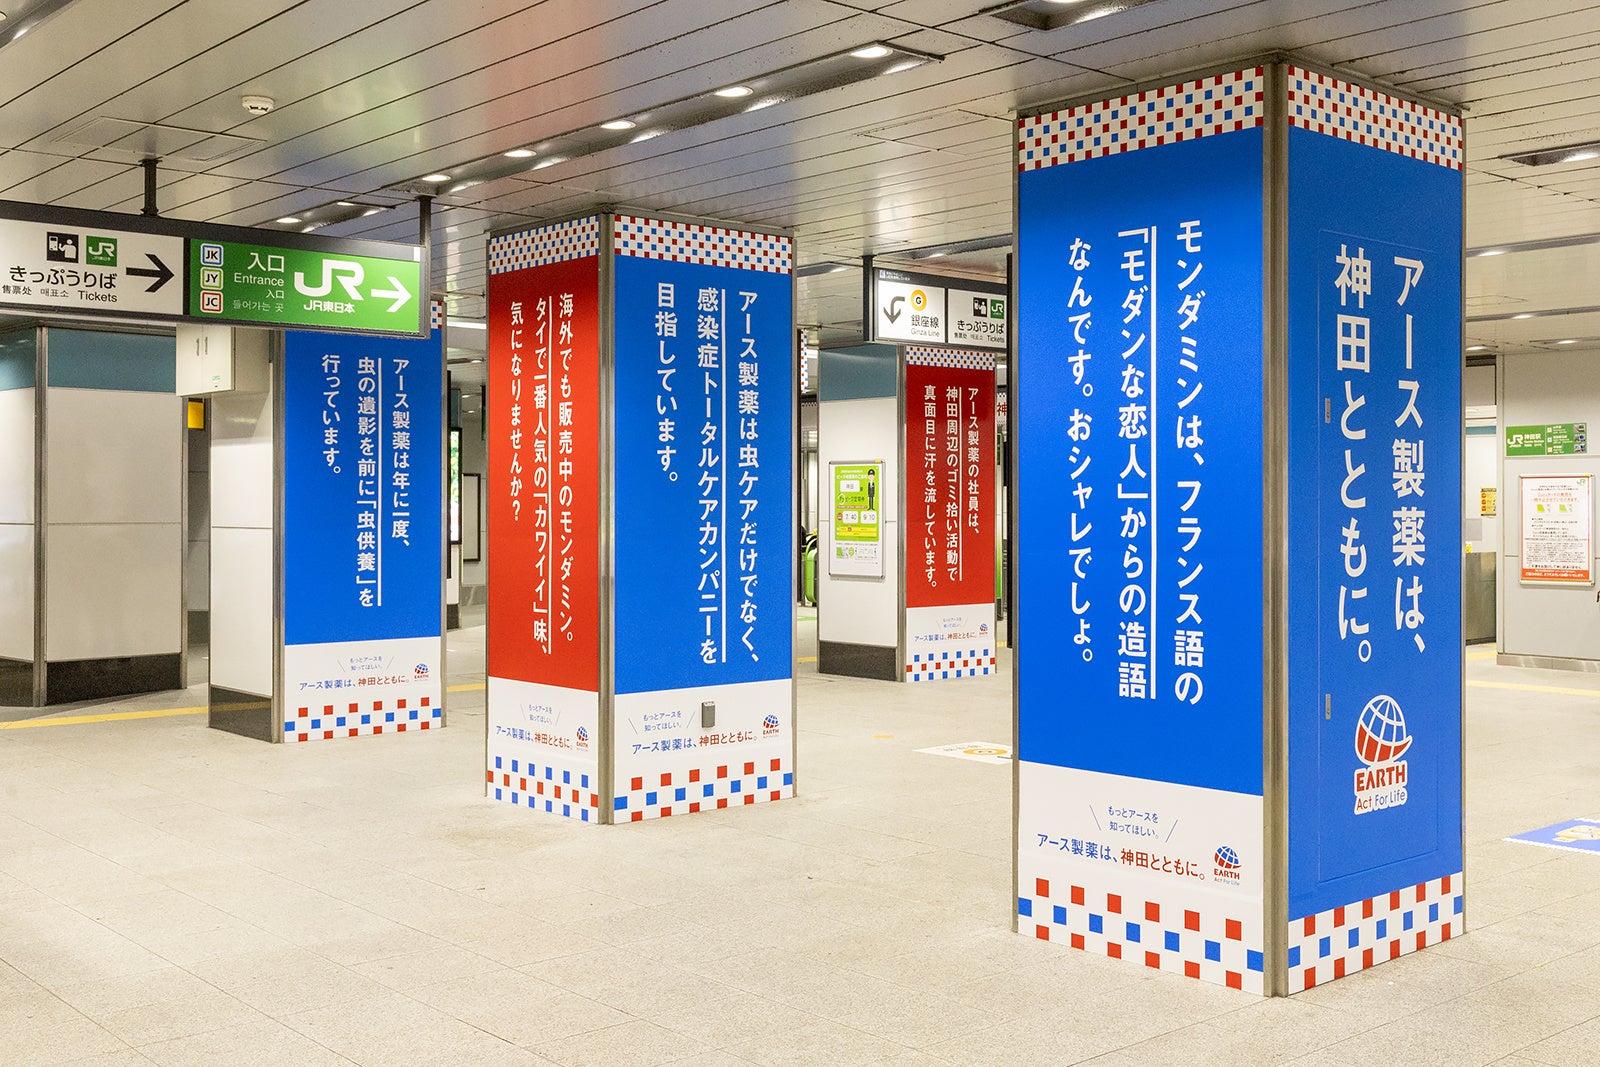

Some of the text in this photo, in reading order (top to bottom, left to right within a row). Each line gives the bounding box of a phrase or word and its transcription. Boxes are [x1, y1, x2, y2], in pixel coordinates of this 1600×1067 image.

[88, 242, 115, 256] JR
[206, 250, 219, 260] JK
[247, 252, 284, 273] 入口
[9, 265, 118, 289] きっぷうりば
[206, 273, 218, 283] JY
[234, 273, 284, 287] Entrance
[294, 258, 365, 300] JR
[78, 290, 118, 303] Tickets
[206, 297, 218, 307] JC
[266, 290, 284, 299] 入口
[915, 296, 922, 305] G
[303, 300, 355, 314] JR東日本
[911, 314, 940, 328] 銀座線
[911, 328, 940, 338] Ginza Line
[987, 335, 1004, 344] Tickets
[655, 282, 678, 483] 目指しています。
[321, 354, 341, 474] 行っています。
[509, 301, 524, 521] 気になりませんか？
[1067, 237, 1094, 662] なんです。おシャレでしょ。
[1507, 434, 1524, 444] JR
[392, 358, 410, 547] アース製薬は年に一度、
[967, 387, 980, 534] アース製薬の社員は、
[1117, 228, 1149, 699] 「モダンな恋人」からの造語
[1174, 219, 1205, 705] モンダミンは、フランス語の
[1333, 243, 1372, 663] 神田とともに。
[1391, 255, 1426, 654] アース製薬は、
[533, 297, 548, 655] タイで一番人気の「カワイイ」味、
[558, 292, 574, 642] 海外でも販売中のモンダミン。
[697, 286, 720, 664] 感染症トータルケアカンパニーを
[738, 289, 760, 663] アース製薬は虫ケアだけでなく、
[356, 356, 377, 608] 虫の遺影を前に「虫供養」を
[924, 384, 937, 588] 真面目に汗を流しています。
[946, 386, 959, 582] 神田周辺のゴミ拾い活動で
[300, 675, 410, 690] アース製薬は、神田とともに。
[643, 710, 682, 722] もっとアースを
[644, 722, 682, 732] 知ってほしい。
[496, 725, 573, 750] アース製薬は、神田とともに。
[632, 730, 758, 755] アース製薬は、神田とともに。
[1356, 764, 1406, 793] EARTH
[1356, 789, 1406, 811] Act For Life
[1108, 806, 1159, 824] もっとアースを
[1109, 821, 1160, 839] 知ってほしい。
[1037, 833, 1205, 881] アース製薬は、神田とともに。
[1214, 868, 1240, 880] EARTH
